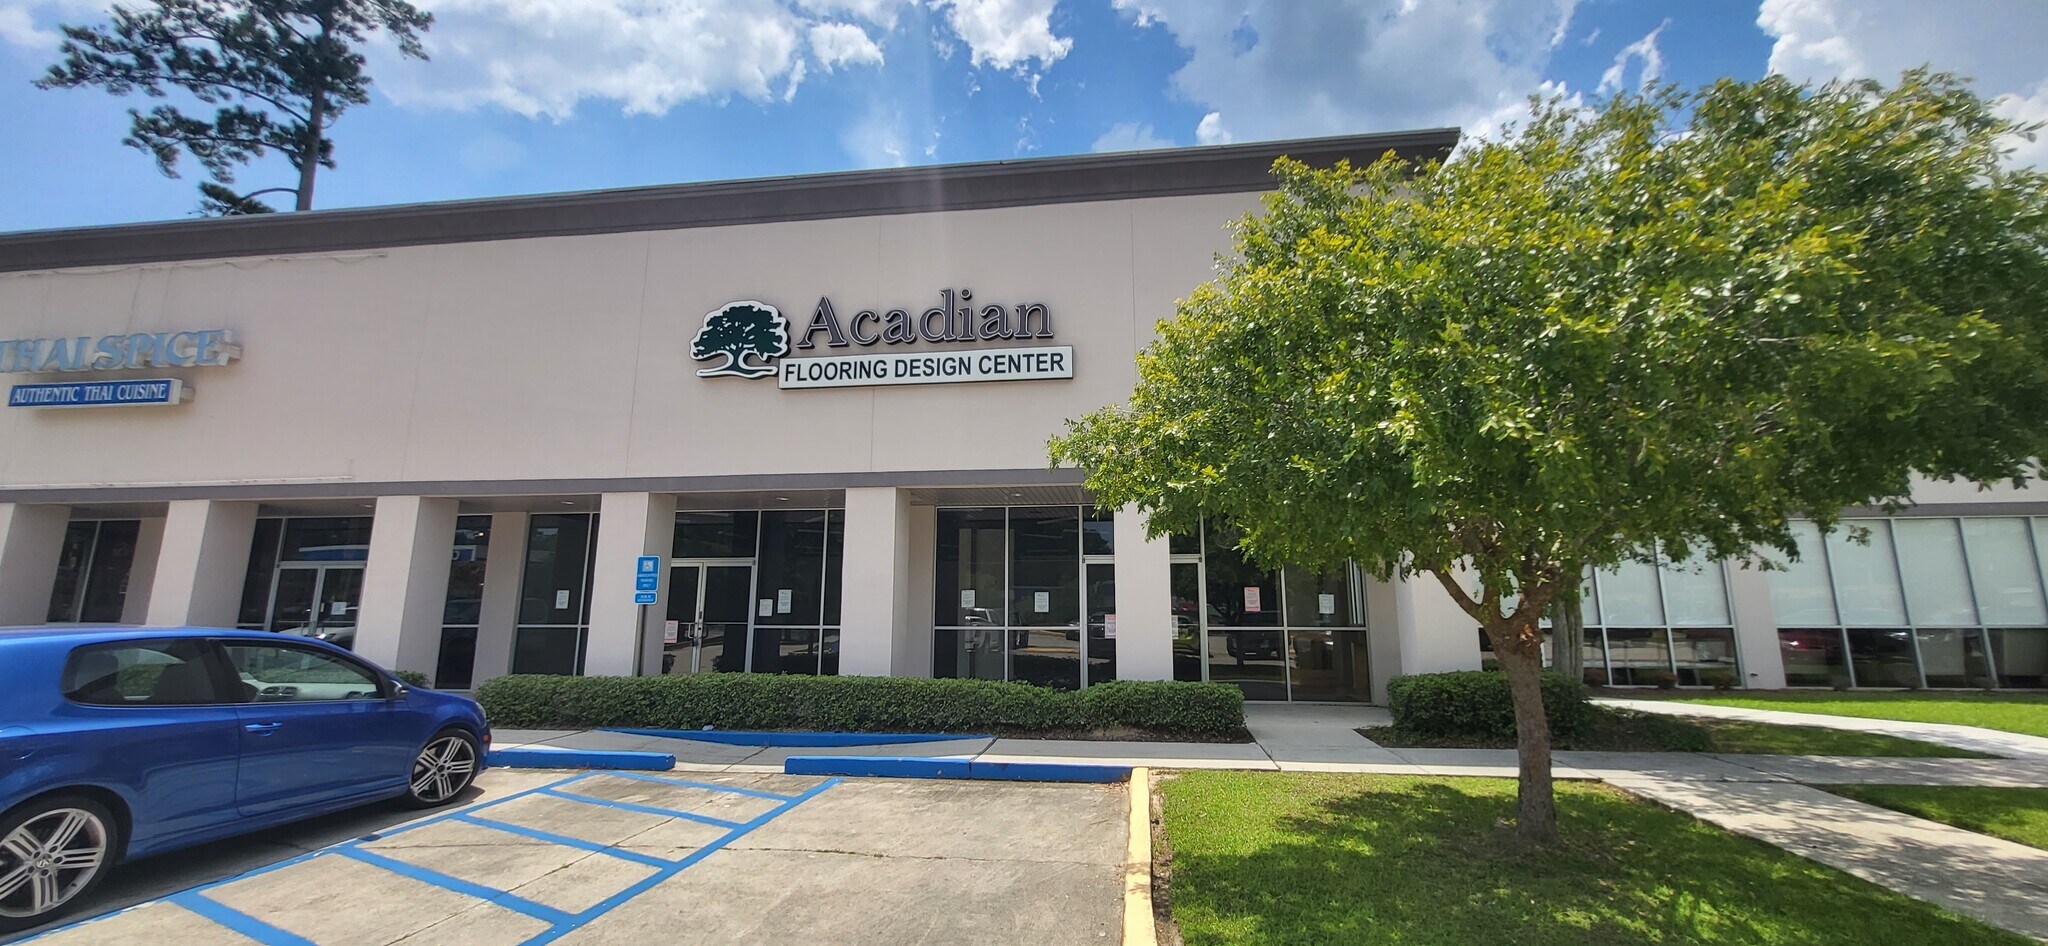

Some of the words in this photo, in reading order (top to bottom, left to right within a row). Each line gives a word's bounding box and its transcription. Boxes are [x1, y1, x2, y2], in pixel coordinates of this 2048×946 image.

[796, 288, 1054, 348] Acadian
[92, 329, 225, 370] SPICE
[784, 360, 888, 382] FLOORING
[894, 355, 971, 378] DESIGN
[978, 352, 1065, 375] CENTER
[12, 386, 80, 403] AUTHENTIC
[84, 385, 114, 401] THAI
[117, 383, 167, 400] CUISINE
